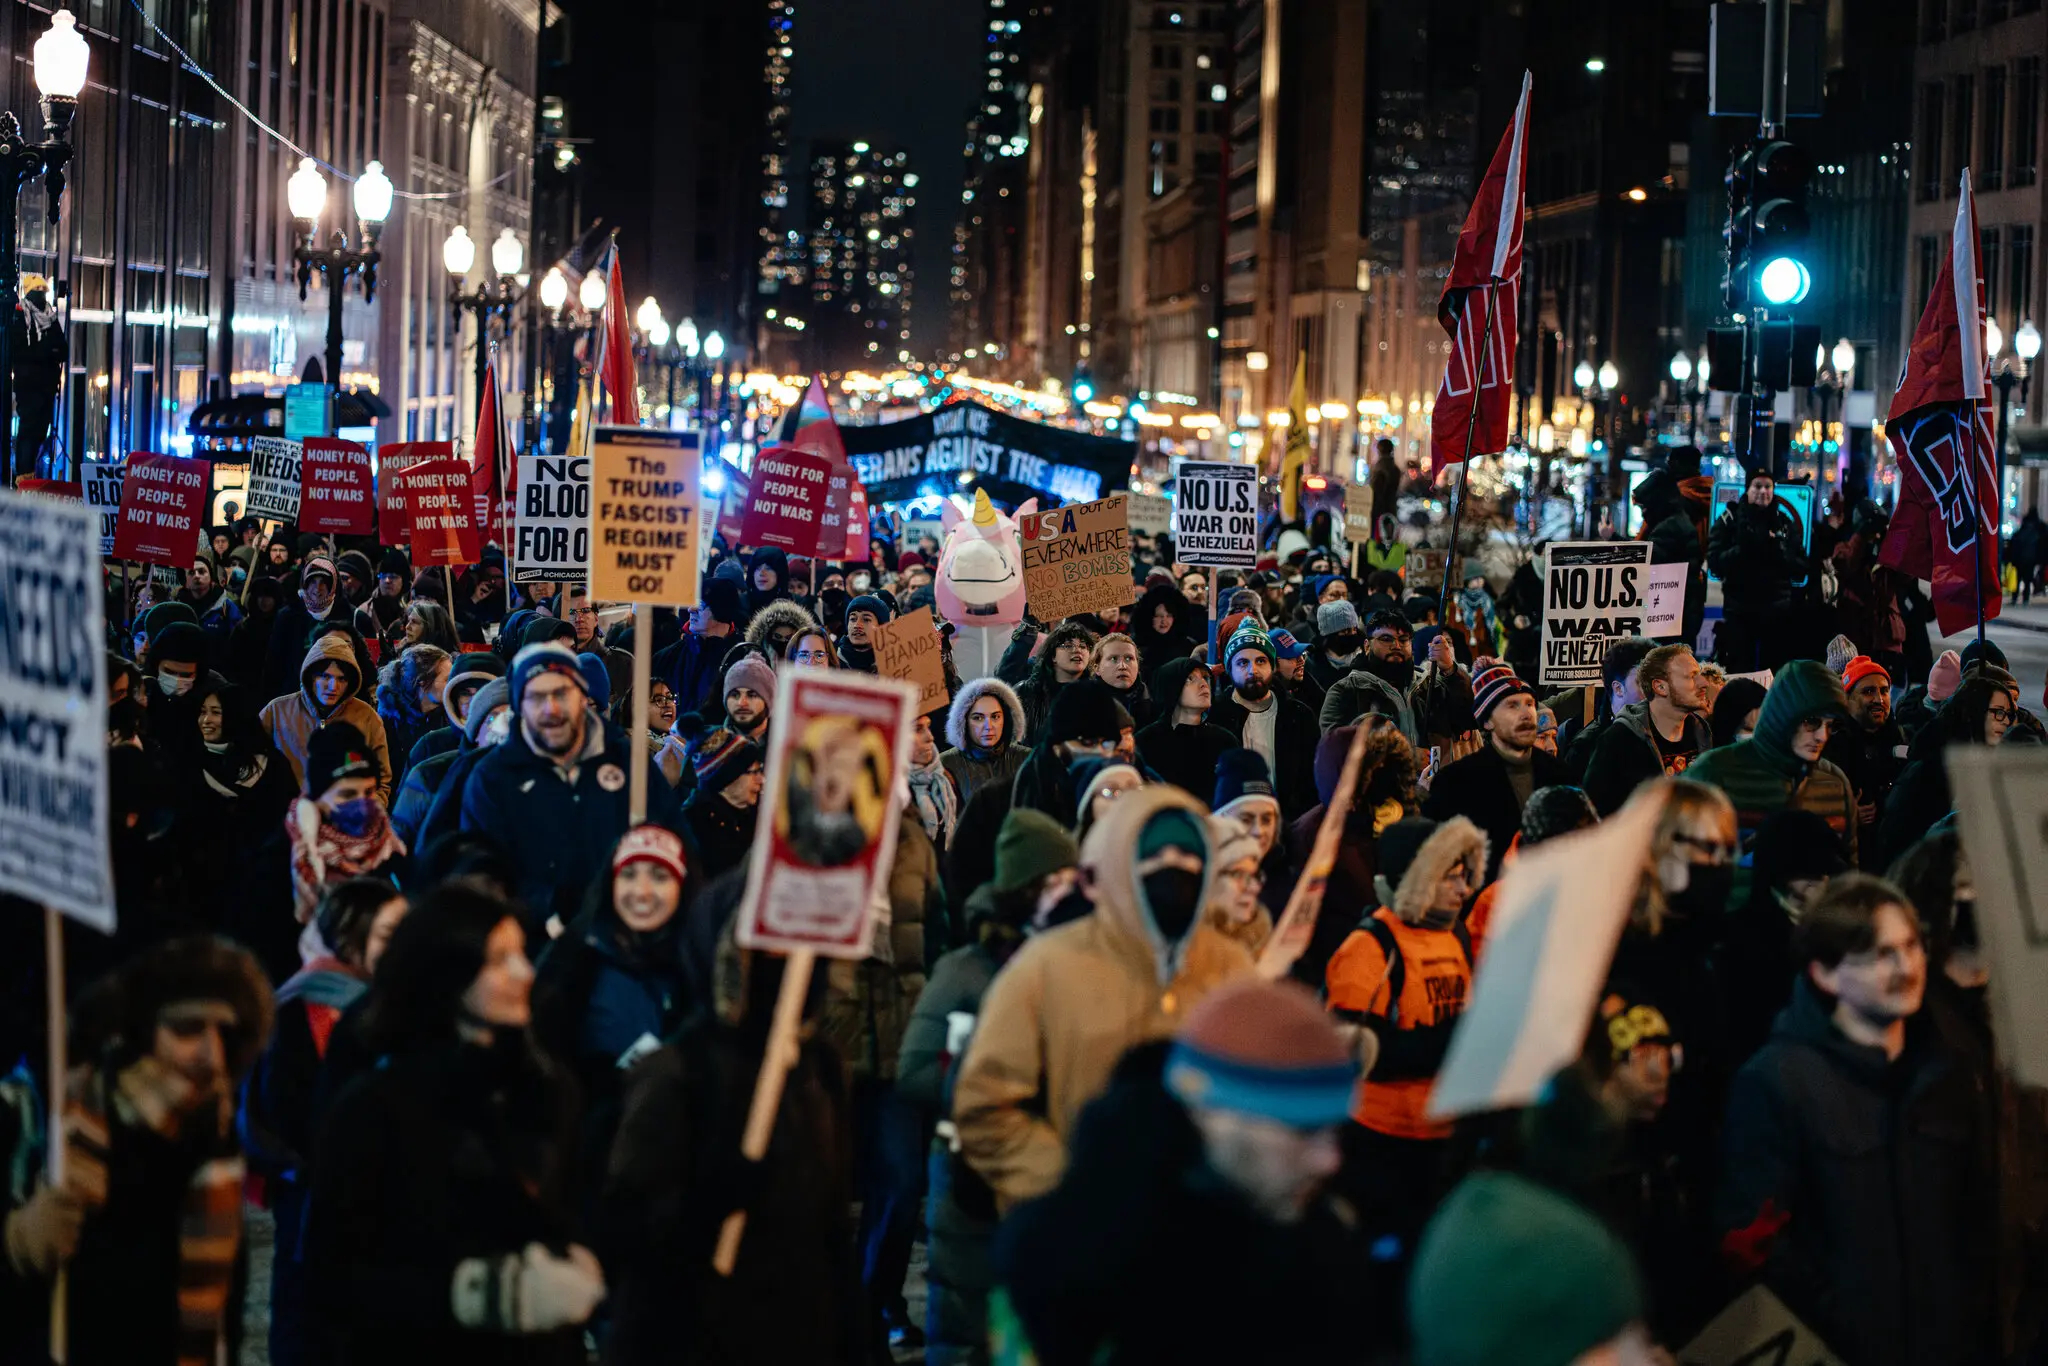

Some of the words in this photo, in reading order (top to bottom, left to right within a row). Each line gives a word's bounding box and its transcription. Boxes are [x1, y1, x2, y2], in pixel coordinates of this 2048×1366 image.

[256, 438, 288, 450] MONEY
[290, 443, 303, 451] FO
[307, 449, 346, 463] MONEY
[347, 452, 368, 464] FOR
[627, 457, 667, 476] The
[130, 464, 175, 483] MONEY
[176, 472, 201, 488] FOR
[315, 469, 359, 484] PEOPLE,
[758, 458, 800, 478] MONEY
[800, 467, 825, 484] FOR
[1009, 449, 1049, 487] THE
[250, 479, 264, 491] NOT
[406, 474, 444, 488] MONEY
[446, 474, 467, 487] FOR
[609, 478, 685, 498] TRUMP
[763, 481, 810, 502] PEOPLE,
[87, 480, 124, 505] BLO
[137, 487, 187, 509] PEOPLE,
[309, 487, 330, 500] NOT
[333, 489, 364, 502] WARS
[418, 495, 461, 509] PEOPLE,
[1180, 479, 1210, 511] NO
[1215, 481, 1255, 513] U.S.
[127, 508, 153, 524] NOT
[156, 513, 191, 530] WARS
[600, 503, 693, 525] FASCIST
[754, 499, 779, 515] NOT
[780, 505, 813, 522] WARS
[1024, 509, 1077, 541] USA
[1080, 502, 1103, 515] OUT
[1107, 498, 1121, 510] OF
[416, 516, 437, 530] NOT
[439, 515, 468, 528] WARS
[1179, 515, 1223, 533] WAR
[1229, 516, 1255, 535] ON
[518, 526, 569, 563] FOR
[604, 528, 688, 549] REGIME
[1023, 528, 1126, 569] EVERYWHERE
[1179, 535, 1255, 551] VENEZUELA
[617, 552, 676, 571] MUST
[1027, 568, 1058, 592] NO
[1062, 551, 1130, 584] BOMBS
[627, 575, 664, 594] GO!
[1550, 567, 1589, 610] NO
[1594, 566, 1643, 609] U.S.
[1648, 580, 1679, 590] STITUION
[1548, 617, 1642, 638] WAR
[885, 632, 936, 670] HANDS
[1546, 670, 1563, 679] PARTY
[1564, 670, 1574, 679] FOR
[1575, 669, 1600, 679] SOCIALISM
